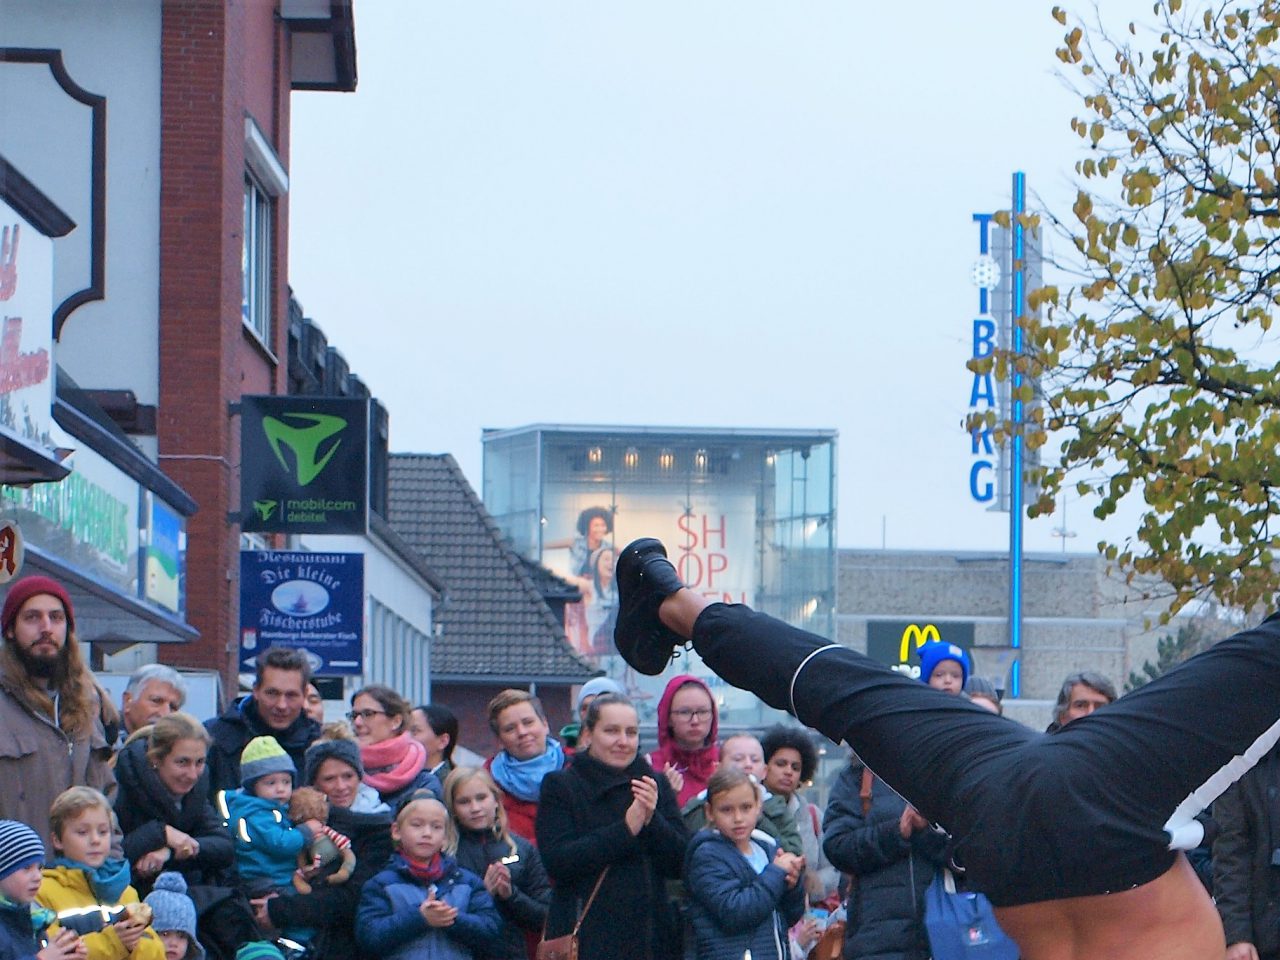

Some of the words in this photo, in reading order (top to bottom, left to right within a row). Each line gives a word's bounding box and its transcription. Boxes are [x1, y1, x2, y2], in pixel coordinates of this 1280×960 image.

[287, 499, 357, 511] mobilcom
[287, 511, 326, 522] debitel
[677, 513, 727, 551] SH
[258, 551, 346, 564] Restaurant
[260, 566, 291, 585] Die
[298, 566, 341, 590] kleine
[677, 552, 729, 589] OP
[259, 607, 343, 630] Fischerstube
